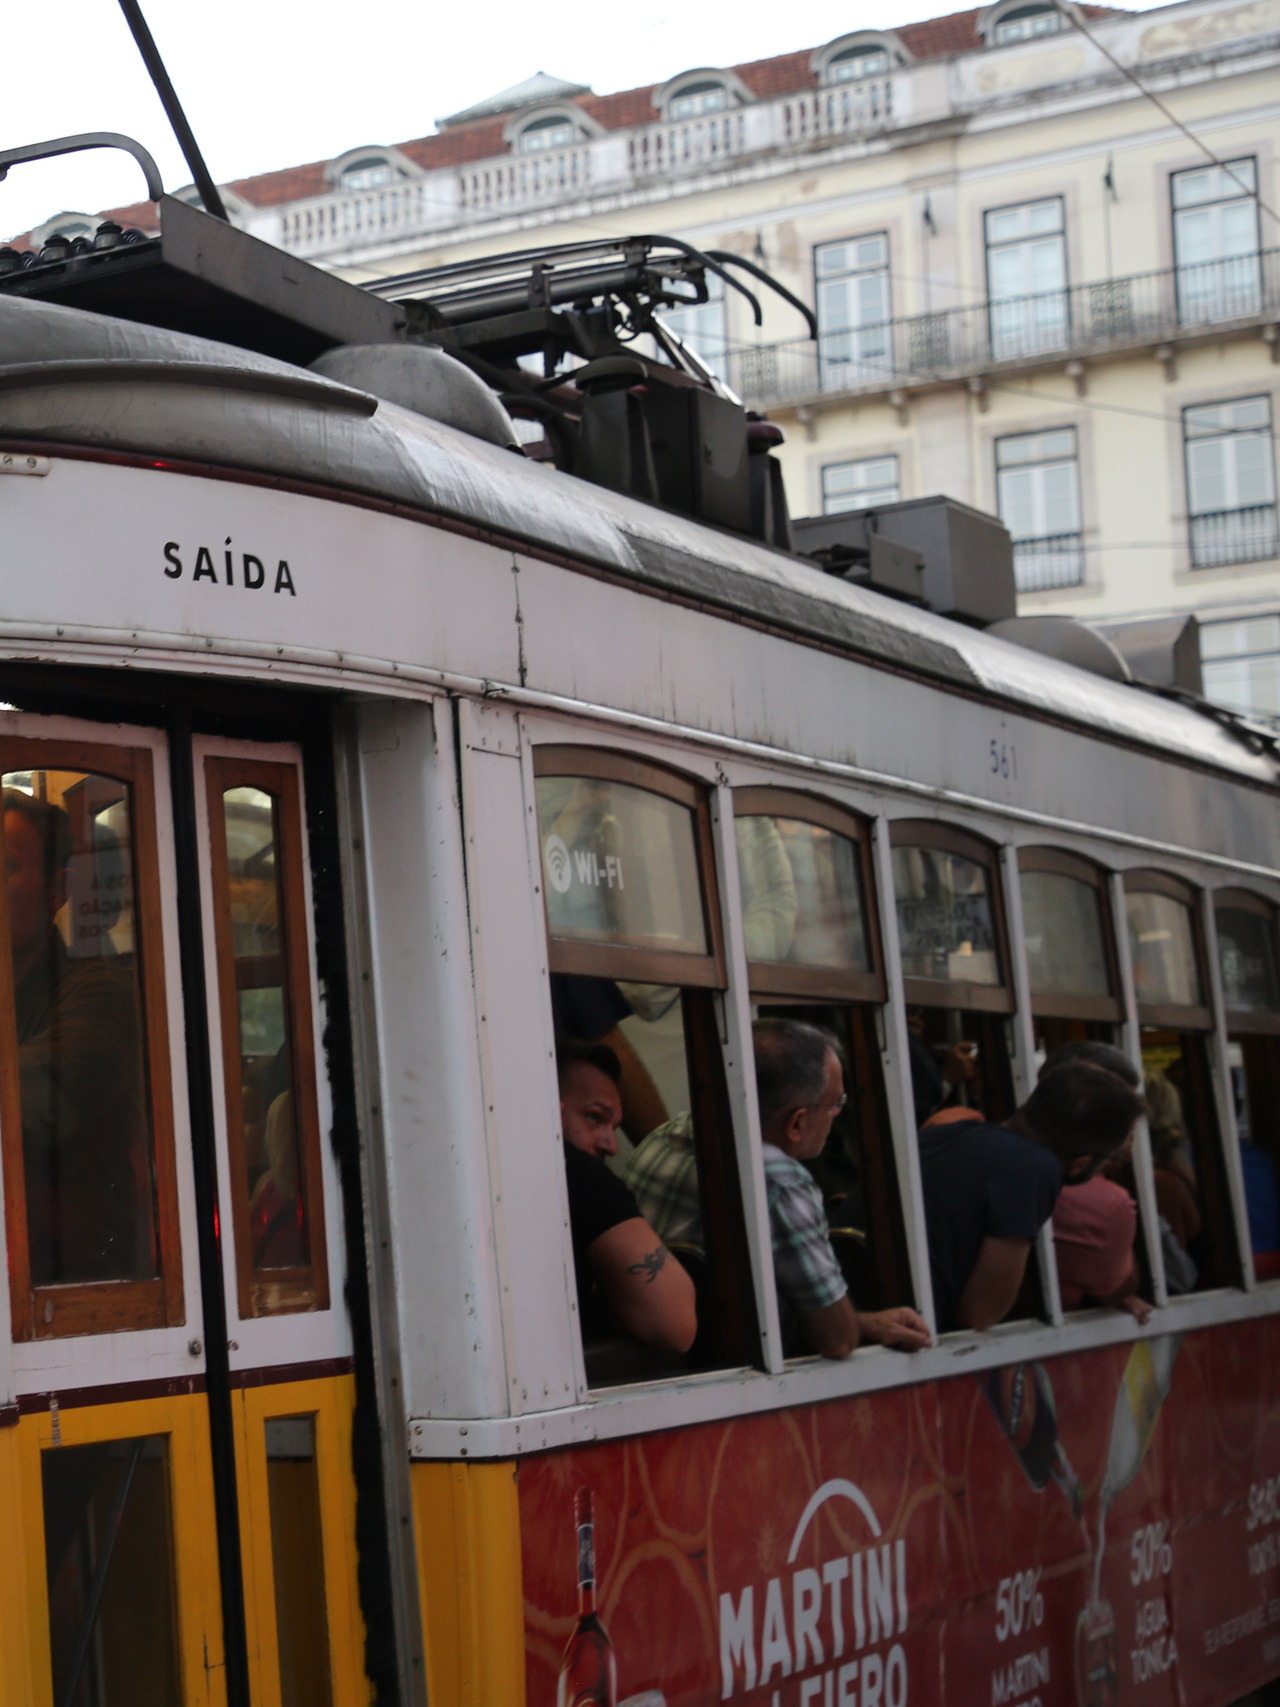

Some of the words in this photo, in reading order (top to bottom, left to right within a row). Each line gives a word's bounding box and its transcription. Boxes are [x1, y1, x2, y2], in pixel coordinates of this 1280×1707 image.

[163, 535, 298, 597] SAÍDA
[989, 738, 1019, 781] 561
[572, 848, 625, 891] WI-FI
[1130, 1519, 1173, 1587] 50%
[719, 1539, 908, 1701] MARTINI
[995, 1564, 1045, 1643] 50%
[991, 1646, 1051, 1707] MARTINI
